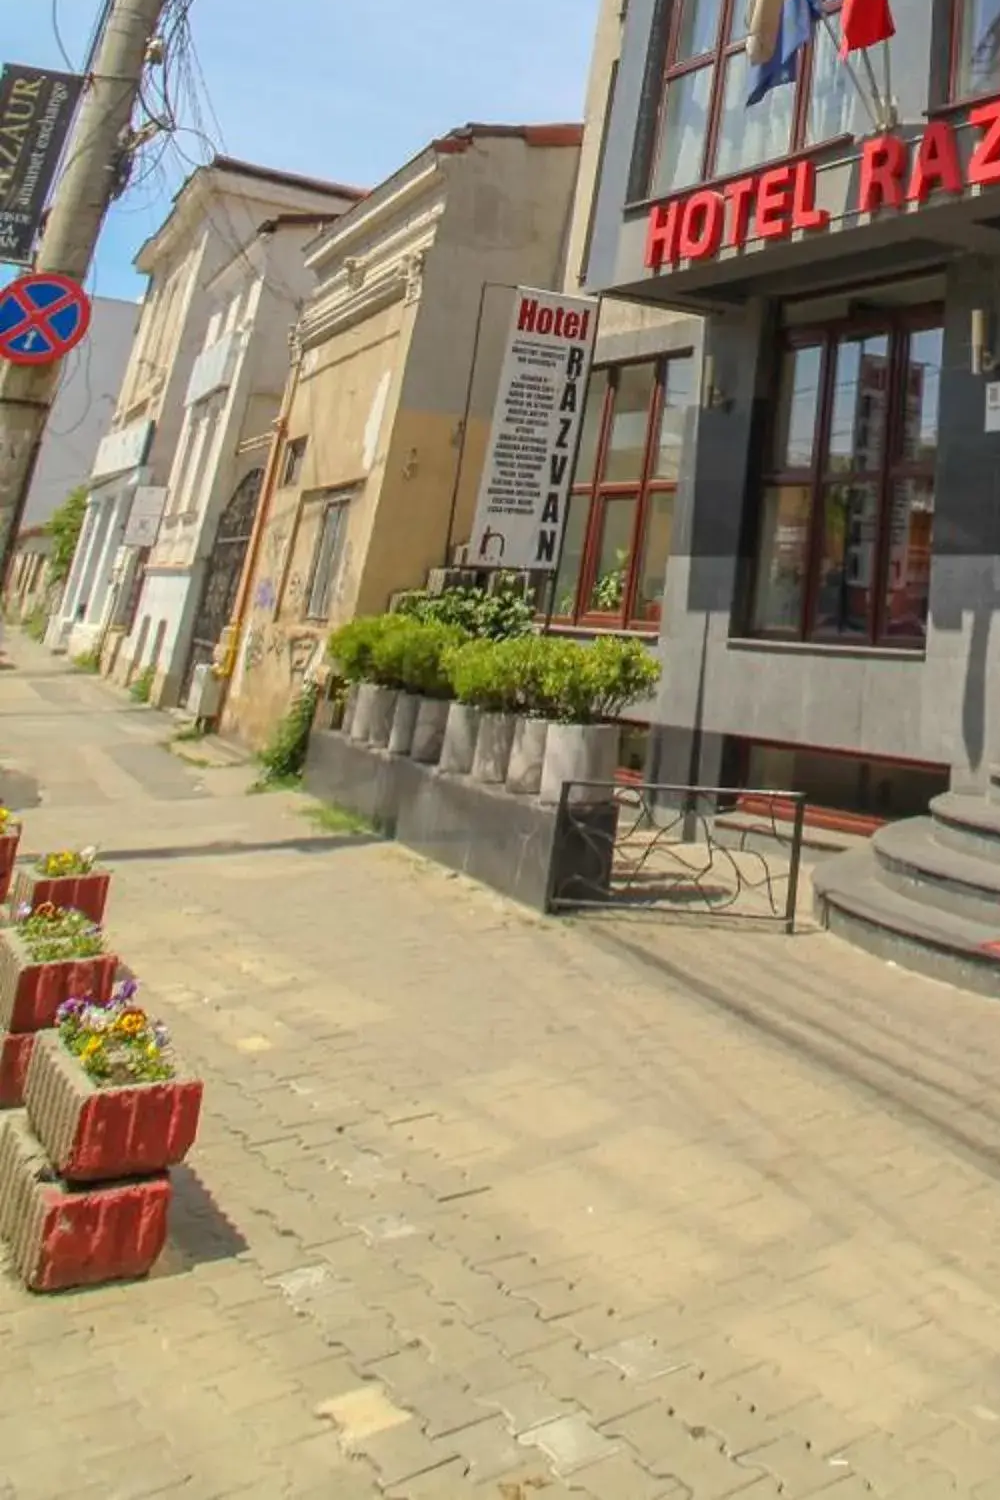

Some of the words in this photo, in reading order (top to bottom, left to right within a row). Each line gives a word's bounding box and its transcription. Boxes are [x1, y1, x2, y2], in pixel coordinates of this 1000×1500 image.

[36, 81, 68, 150] exchange
[644, 160, 828, 268] HOTEL
[517, 299, 590, 341] Hotel
